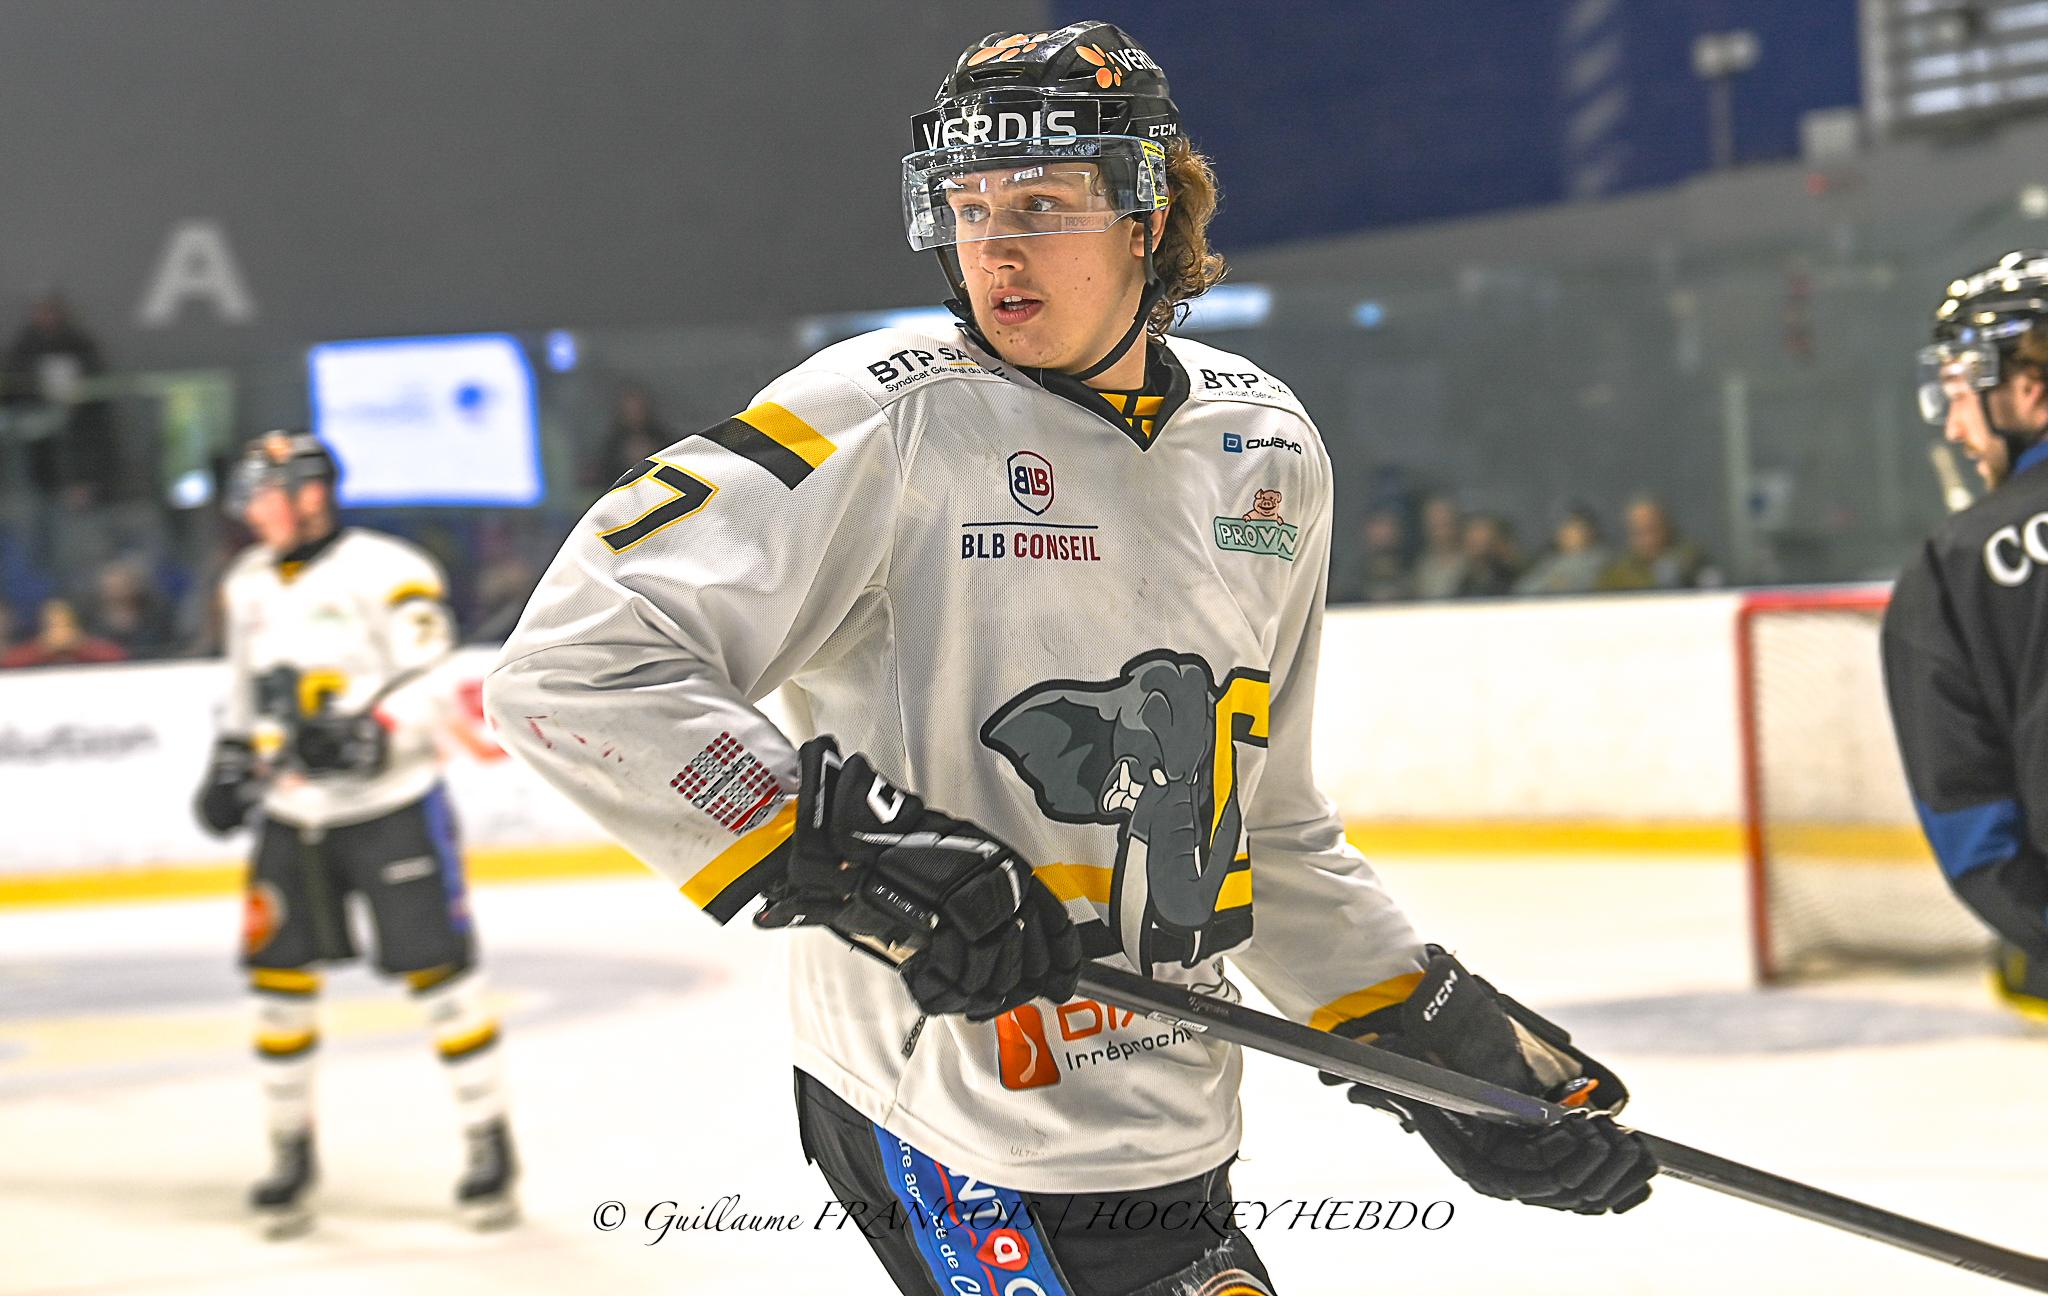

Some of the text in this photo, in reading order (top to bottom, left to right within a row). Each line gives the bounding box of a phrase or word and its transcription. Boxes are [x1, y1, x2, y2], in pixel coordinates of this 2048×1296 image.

[922, 110, 1077, 156] VERDIS
[1148, 123, 1177, 138] CCM
[867, 349, 935, 384] BTP
[1199, 368, 1260, 389] BTP
[885, 370, 931, 393] Syndicat
[961, 532, 1101, 562] BLB CONSEIL
[1423, 969, 1459, 1022] CCM
[940, 1243, 960, 1269] de
